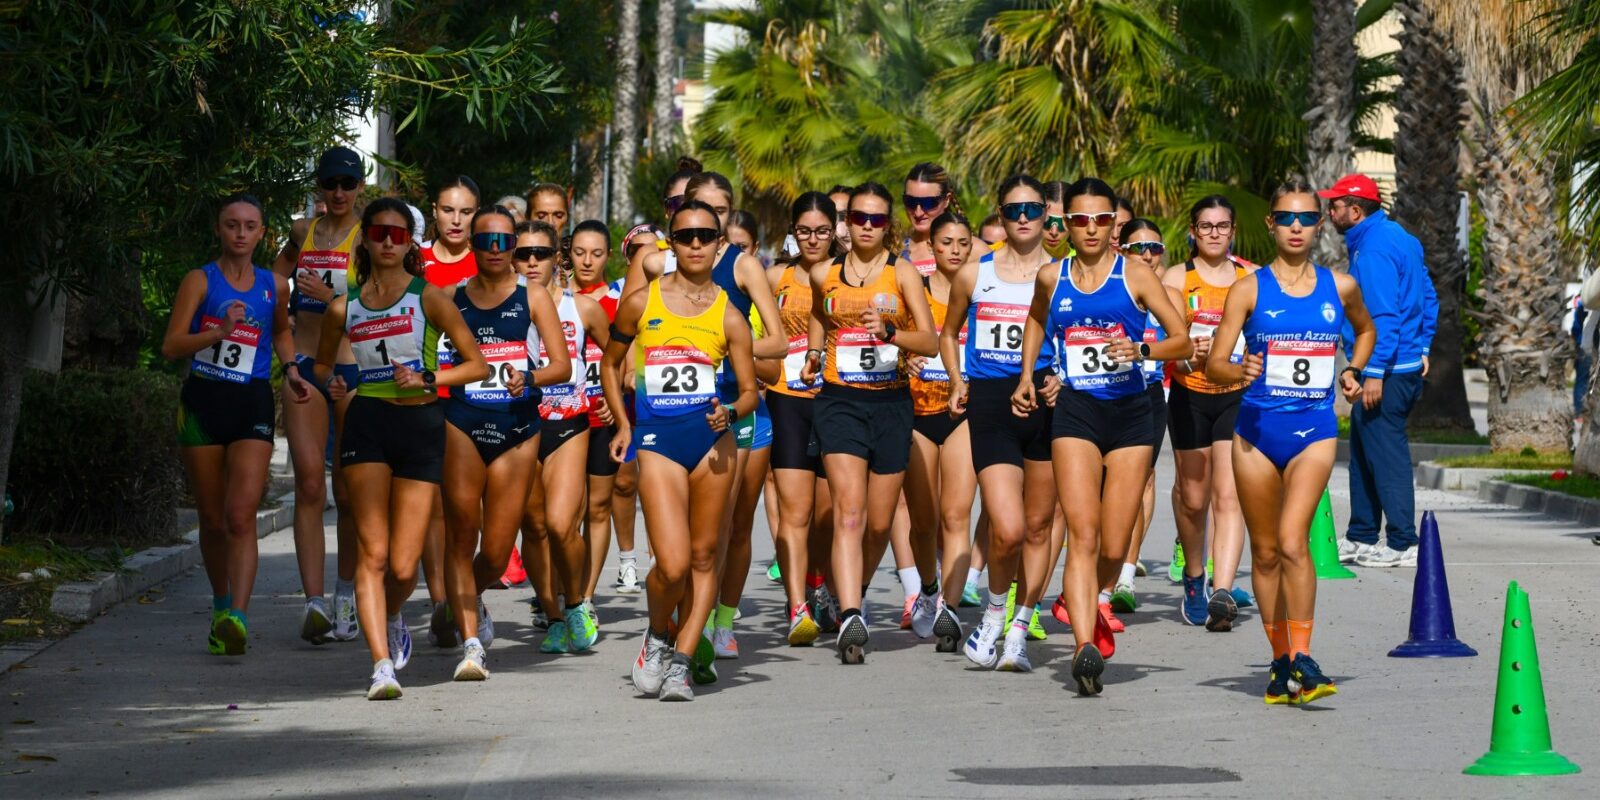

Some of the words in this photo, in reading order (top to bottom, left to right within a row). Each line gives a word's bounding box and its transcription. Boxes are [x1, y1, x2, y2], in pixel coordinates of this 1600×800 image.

[204, 321, 258, 340] FREROSSA
[353, 319, 409, 334] FRECCIAROSSA
[477, 327, 495, 336] CUS
[990, 324, 1023, 350] 19
[1069, 328, 1122, 339] FRECCIAROSSA
[1256, 332, 1301, 343] Fiamme
[480, 345, 525, 355] CCIAROSSA
[1272, 341, 1334, 349] FRECCIAROSSA
[211, 340, 242, 369] 13
[375, 339, 390, 366] 1
[980, 352, 1010, 361] ANCONA
[859, 347, 876, 371] 5
[196, 364, 226, 377] ANCONA
[226, 370, 246, 382] 2026
[924, 372, 950, 380] ANCON
[1292, 358, 1311, 386] 8
[660, 365, 699, 393] 23
[843, 374, 875, 382] ANCONA
[1074, 377, 1110, 386] ANCONA
[1111, 374, 1130, 383] 2026
[1271, 388, 1308, 398] ANCONA
[653, 397, 689, 406] ANCONA
[485, 422, 497, 430] CUS
[477, 436, 501, 444] MILANO
[486, 429, 506, 441] PATRIA
